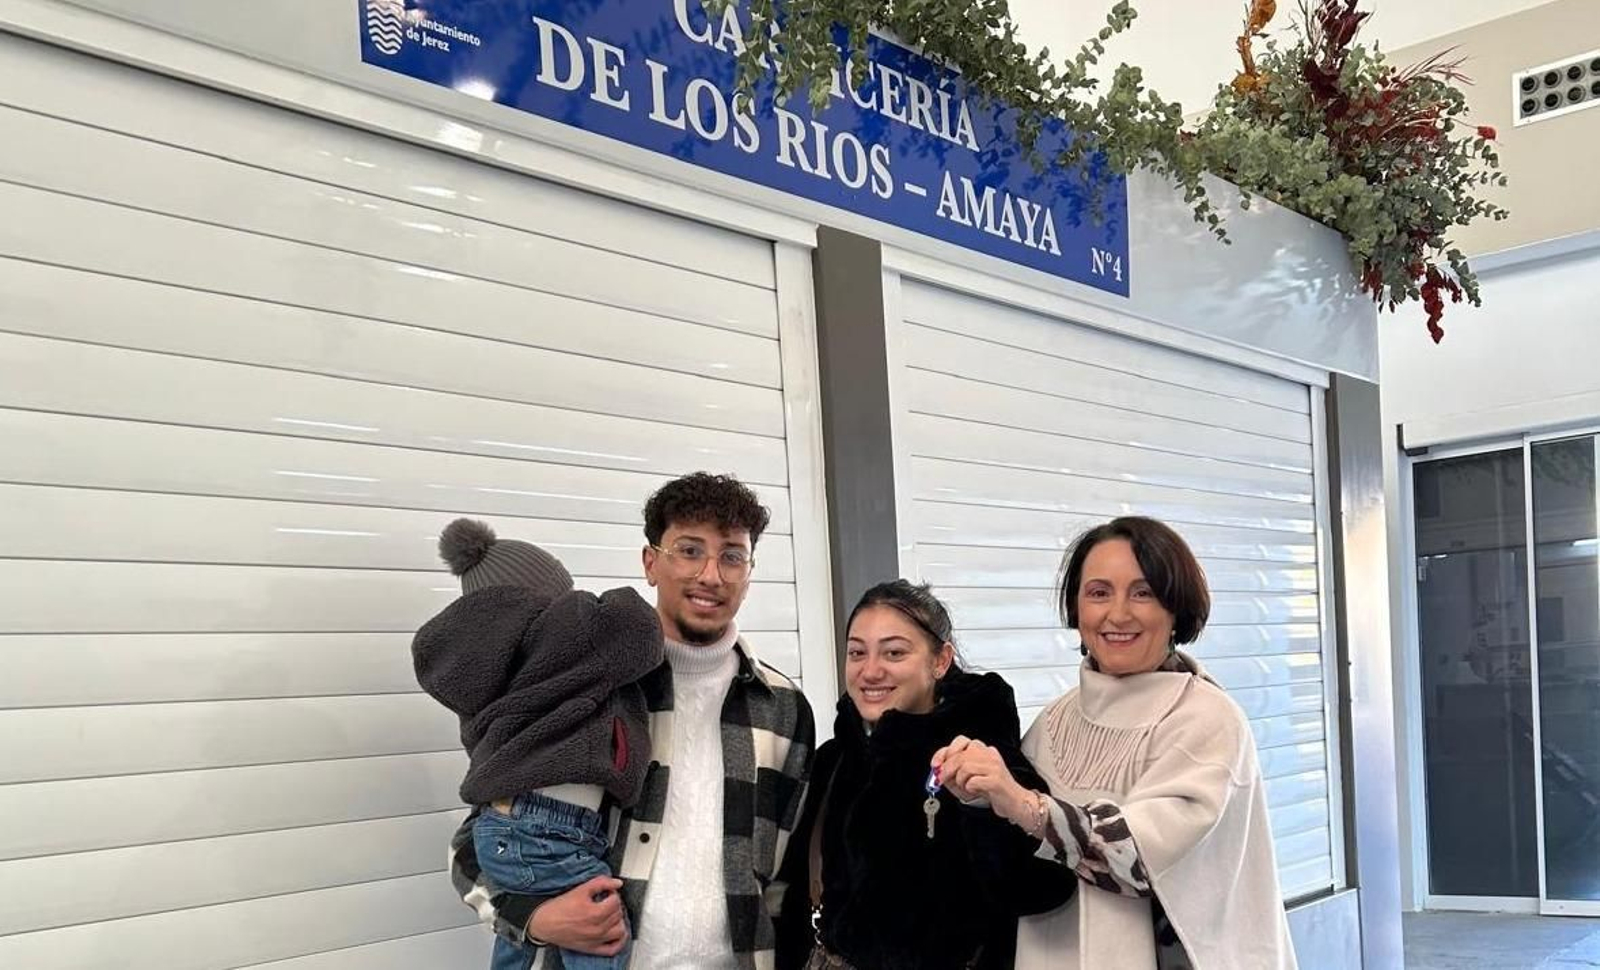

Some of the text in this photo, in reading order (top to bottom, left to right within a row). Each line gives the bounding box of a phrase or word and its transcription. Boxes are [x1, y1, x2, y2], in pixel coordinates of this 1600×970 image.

[406, 27, 449, 51] de Jerez
[674, 0, 980, 152] CAICERÍA
[532, 16, 630, 112] DE
[645, 59, 760, 154] LOS
[773, 106, 894, 200] RIOS
[936, 170, 1062, 257] AMAYA
